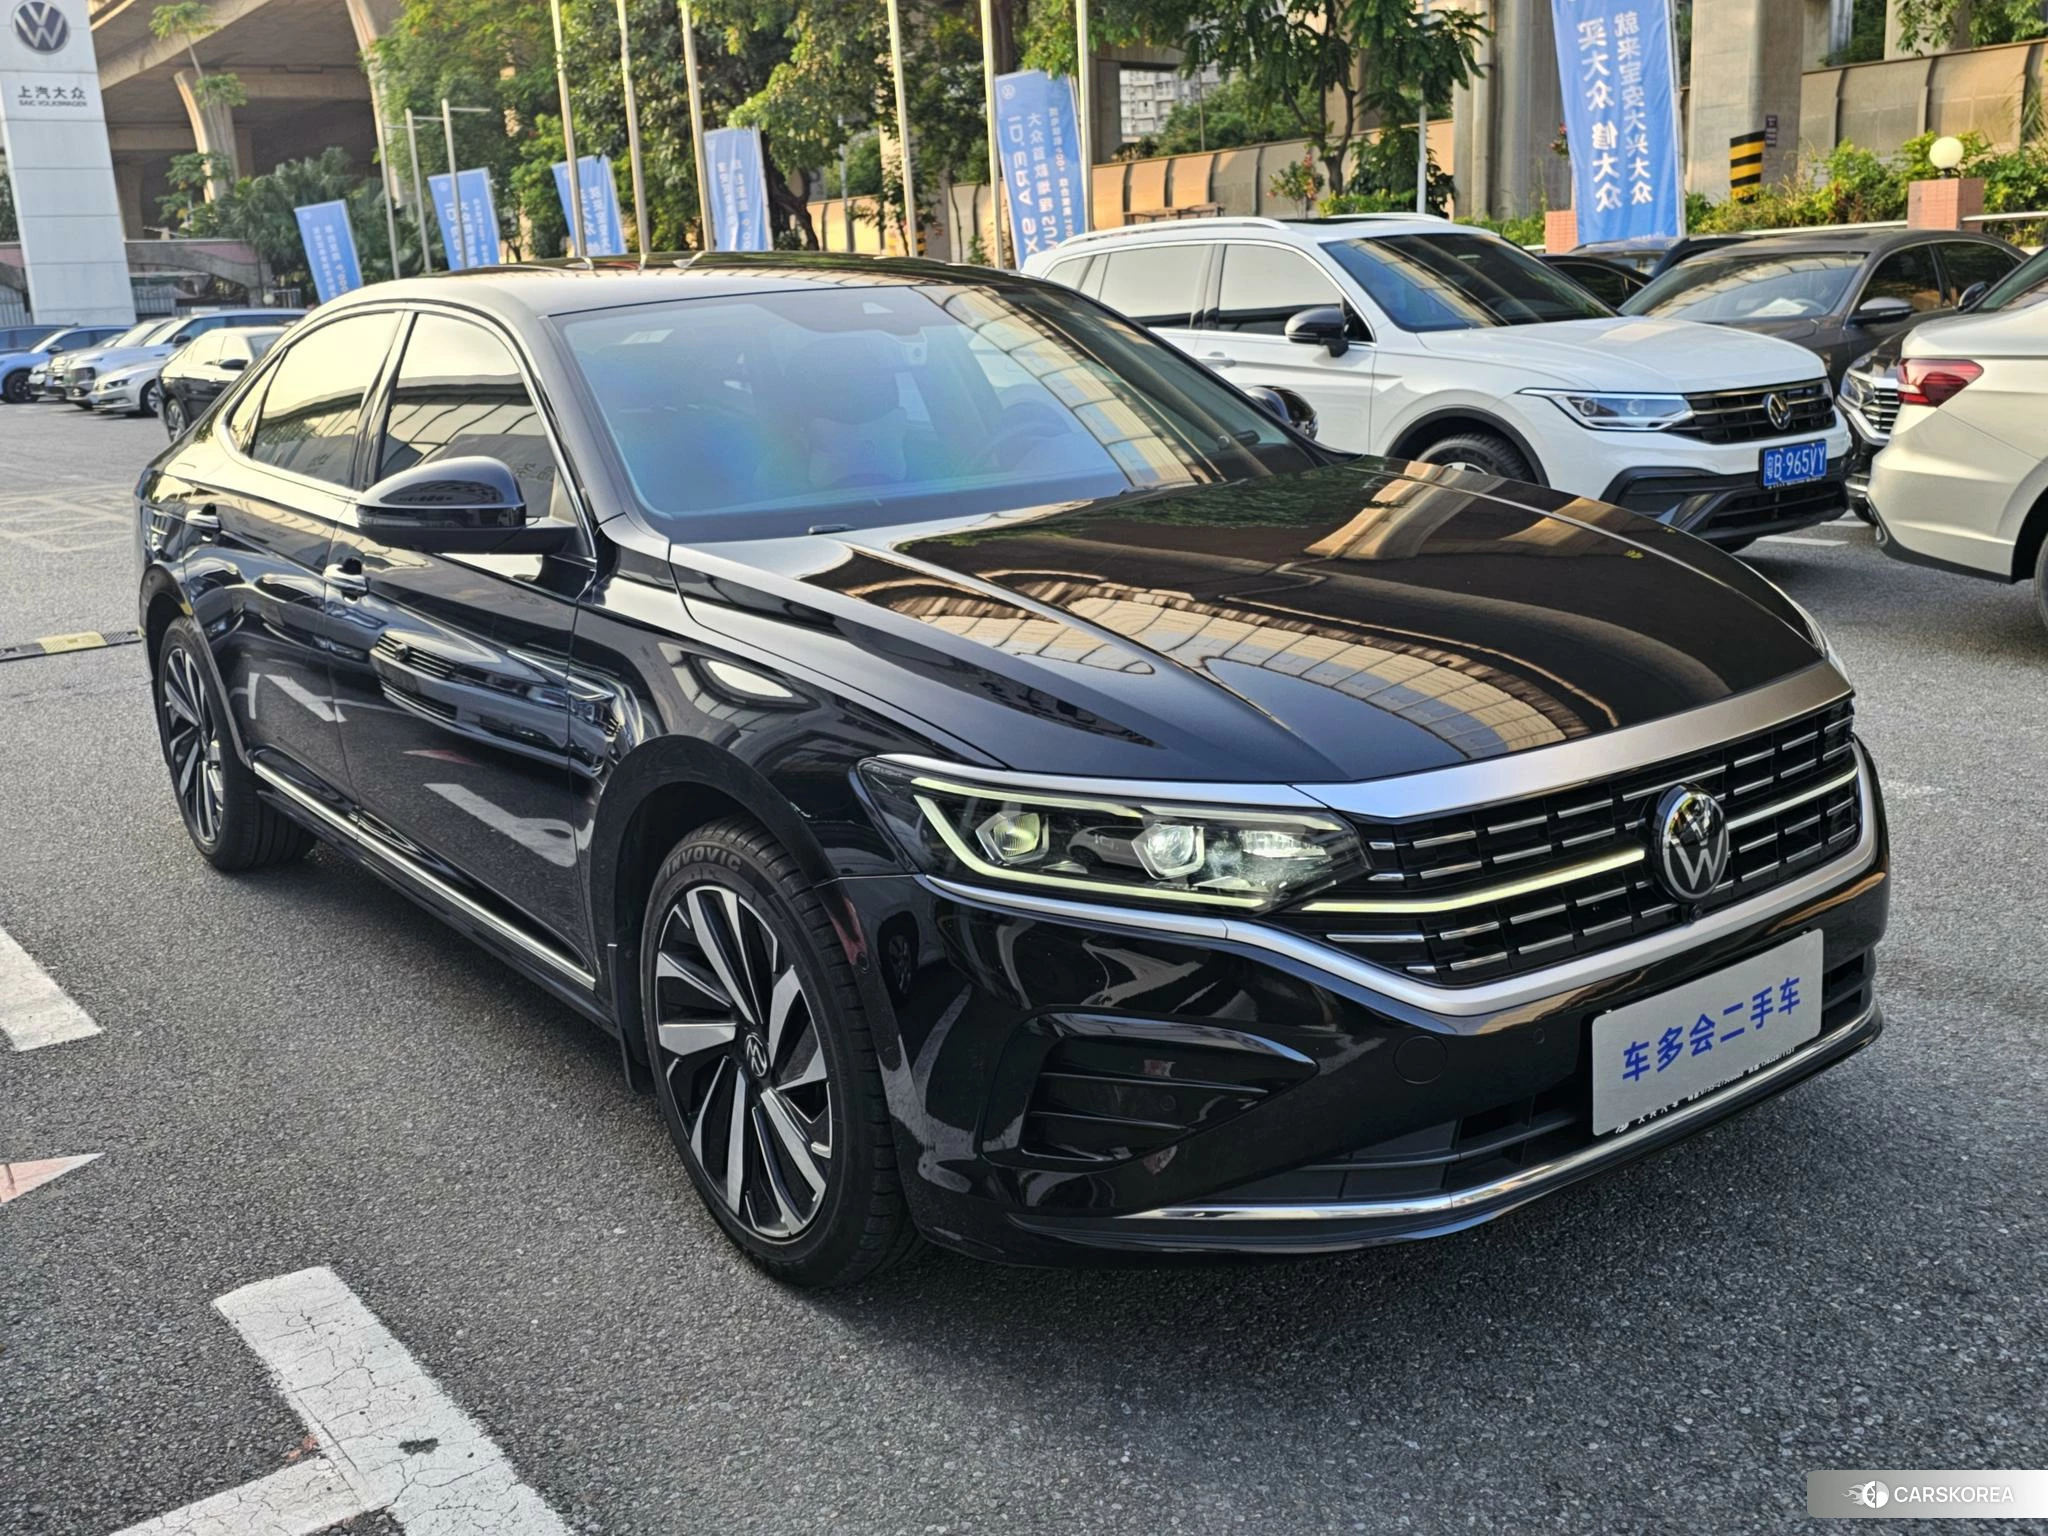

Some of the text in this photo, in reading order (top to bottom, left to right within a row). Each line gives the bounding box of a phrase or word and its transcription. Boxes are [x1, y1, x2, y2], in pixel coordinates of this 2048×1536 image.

[17, 85, 86, 100] 上汽大众
[664, 846, 742, 879] INVOVIC
[1622, 977, 1801, 1082] 车多会二手车
